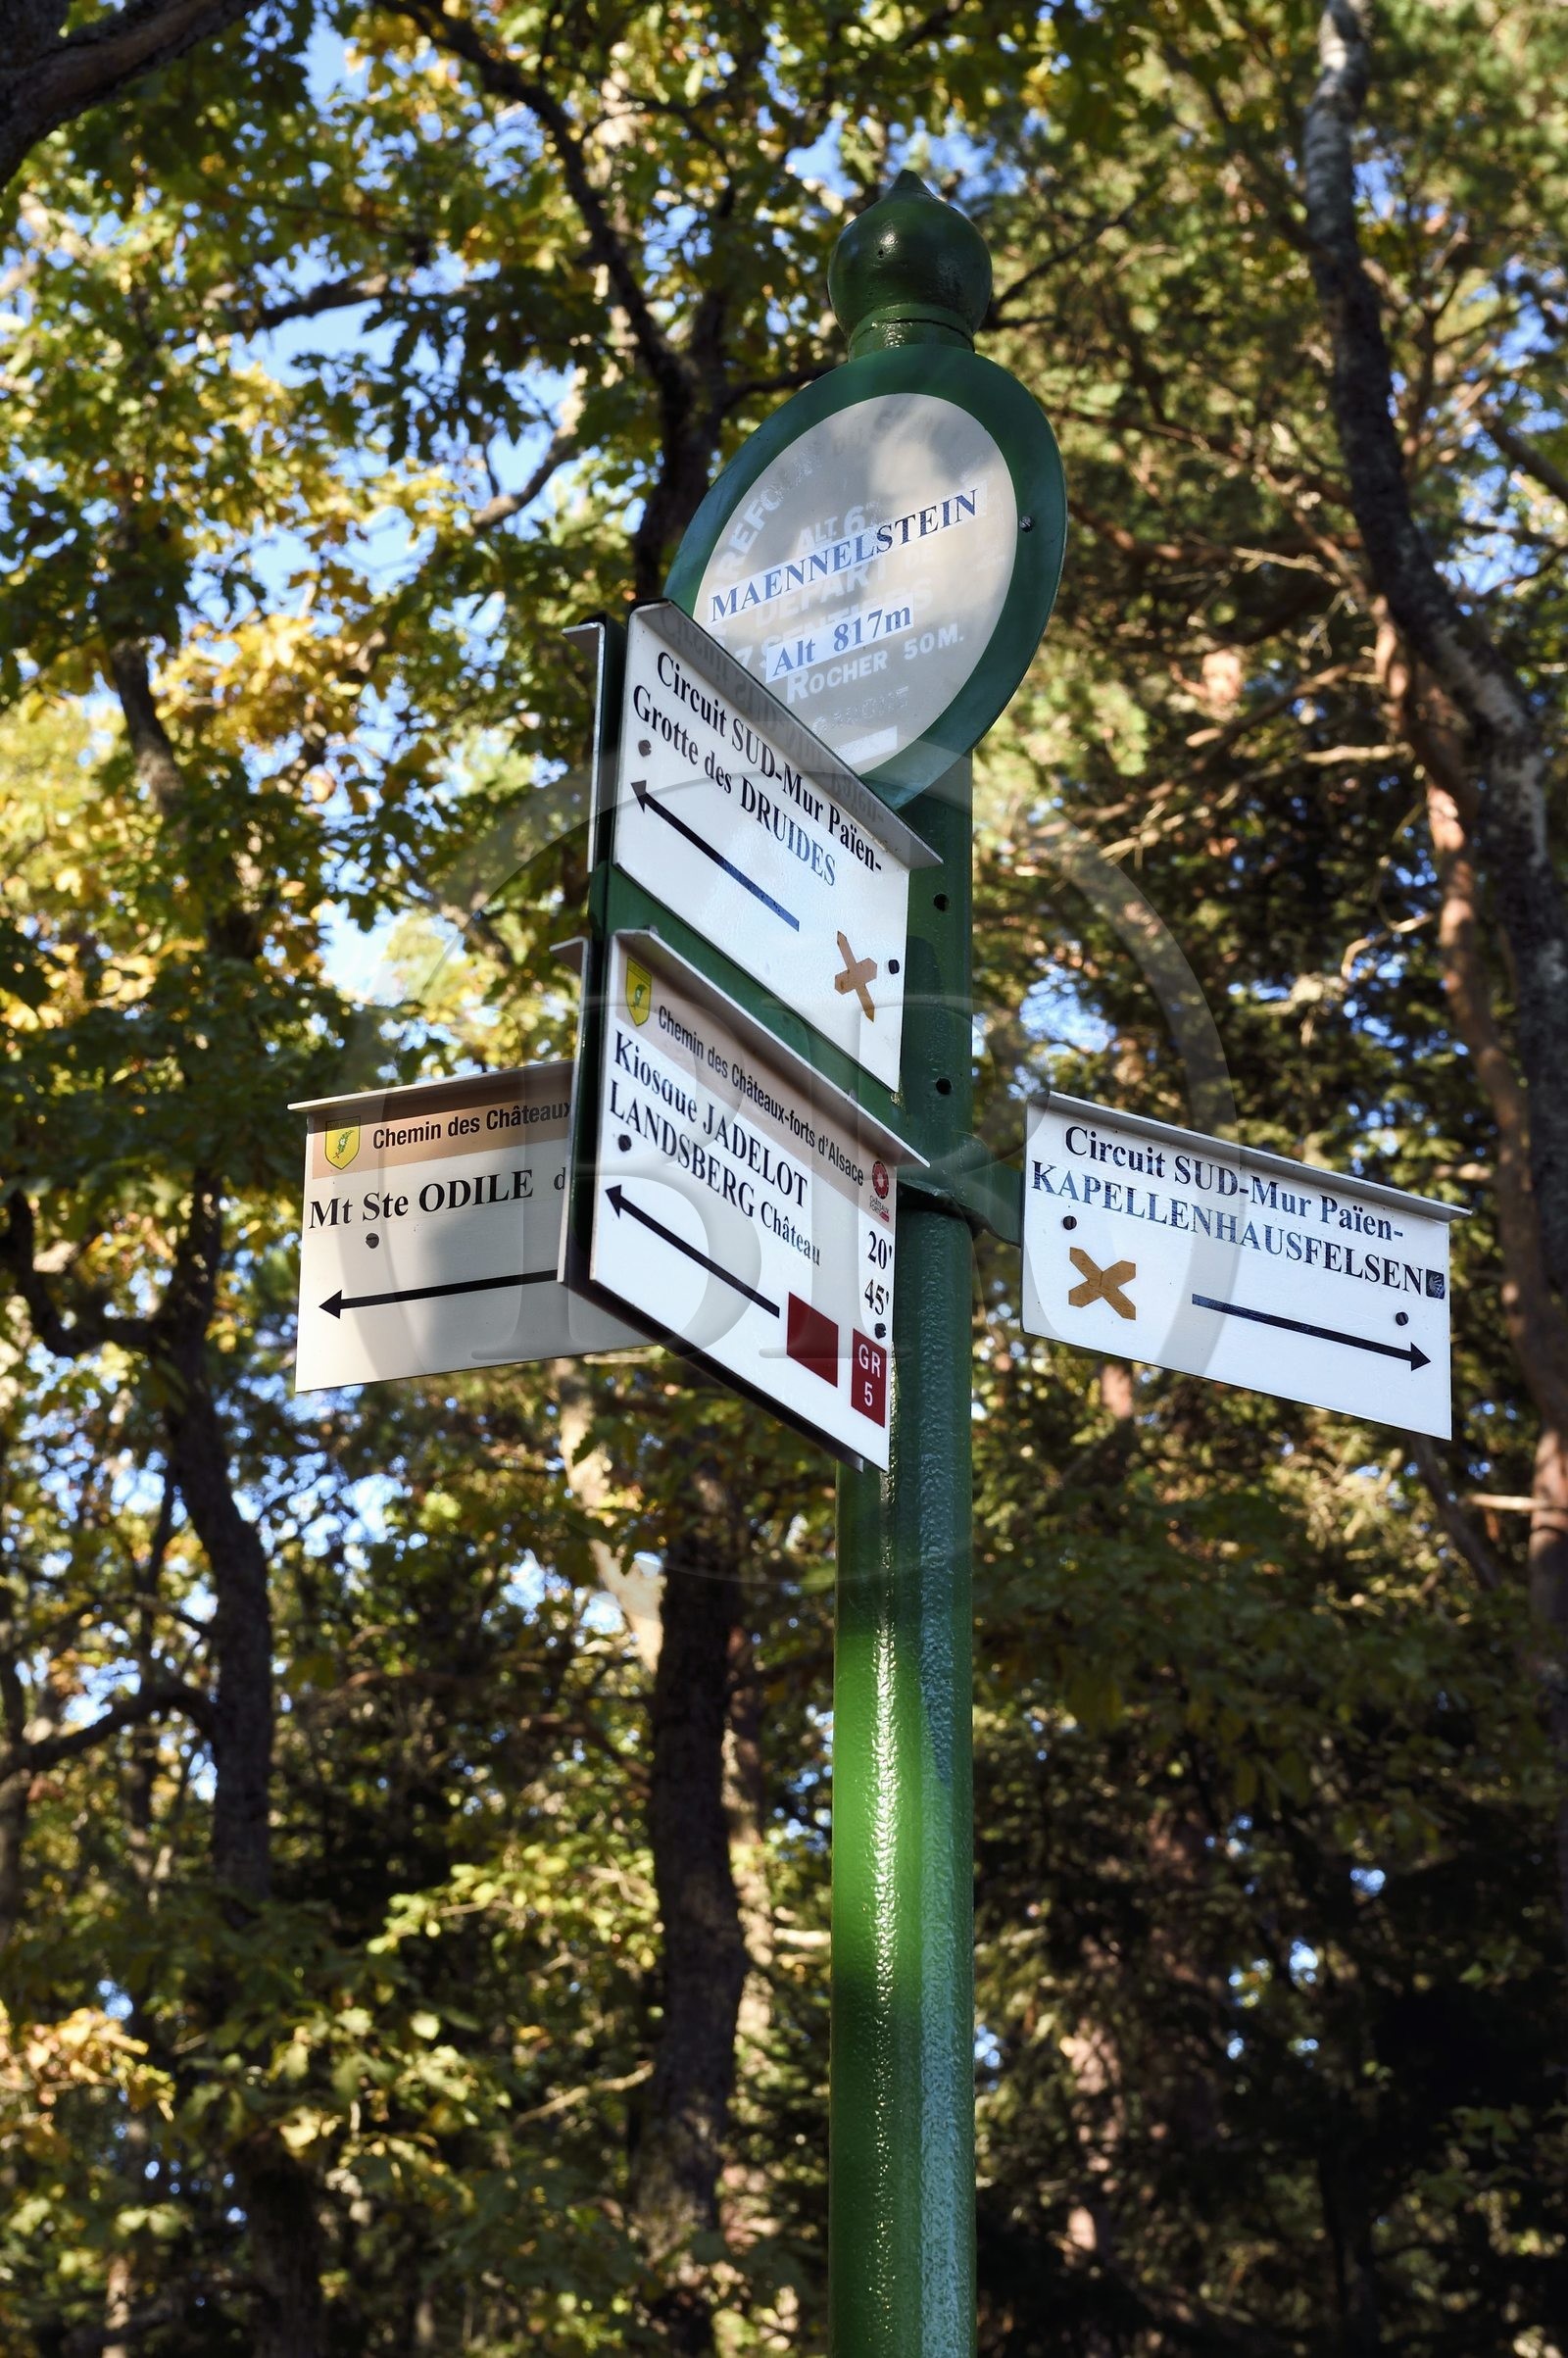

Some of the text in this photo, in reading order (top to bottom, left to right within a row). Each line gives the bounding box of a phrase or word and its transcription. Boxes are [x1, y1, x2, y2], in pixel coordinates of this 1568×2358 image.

[710, 488, 978, 623] MAENNELSTEIN
[772, 638, 816, 677] Alt
[833, 606, 912, 653] 817m
[786, 650, 889, 705] ROCHER
[632, 684, 699, 766] Grotte
[704, 752, 732, 794] des
[740, 776, 836, 887] DRUIDES
[657, 651, 728, 738] Circuit
[732, 717, 825, 824] SUD-Mur
[828, 801, 883, 873] Païen-
[372, 1119, 442, 1151] Chemin
[447, 1116, 481, 1137] des
[614, 1030, 808, 1209] Kiosque JADELOT
[659, 1005, 864, 1187] Chemin des Châteaux-forts d'Alsace
[308, 1197, 353, 1230] Mt
[362, 1191, 410, 1222] Ste
[418, 1168, 535, 1213] ODILE
[609, 1078, 821, 1267] LANDSBERG Château
[1064, 1125, 1404, 1242] Circuit SUD-Mur Païen-
[867, 1230, 893, 1270] 20'
[1030, 1159, 1425, 1297] KAPELLENHAUSFELSEN
[863, 1278, 891, 1316] 45'
[858, 1344, 882, 1379] GR
[863, 1381, 874, 1407] 5
